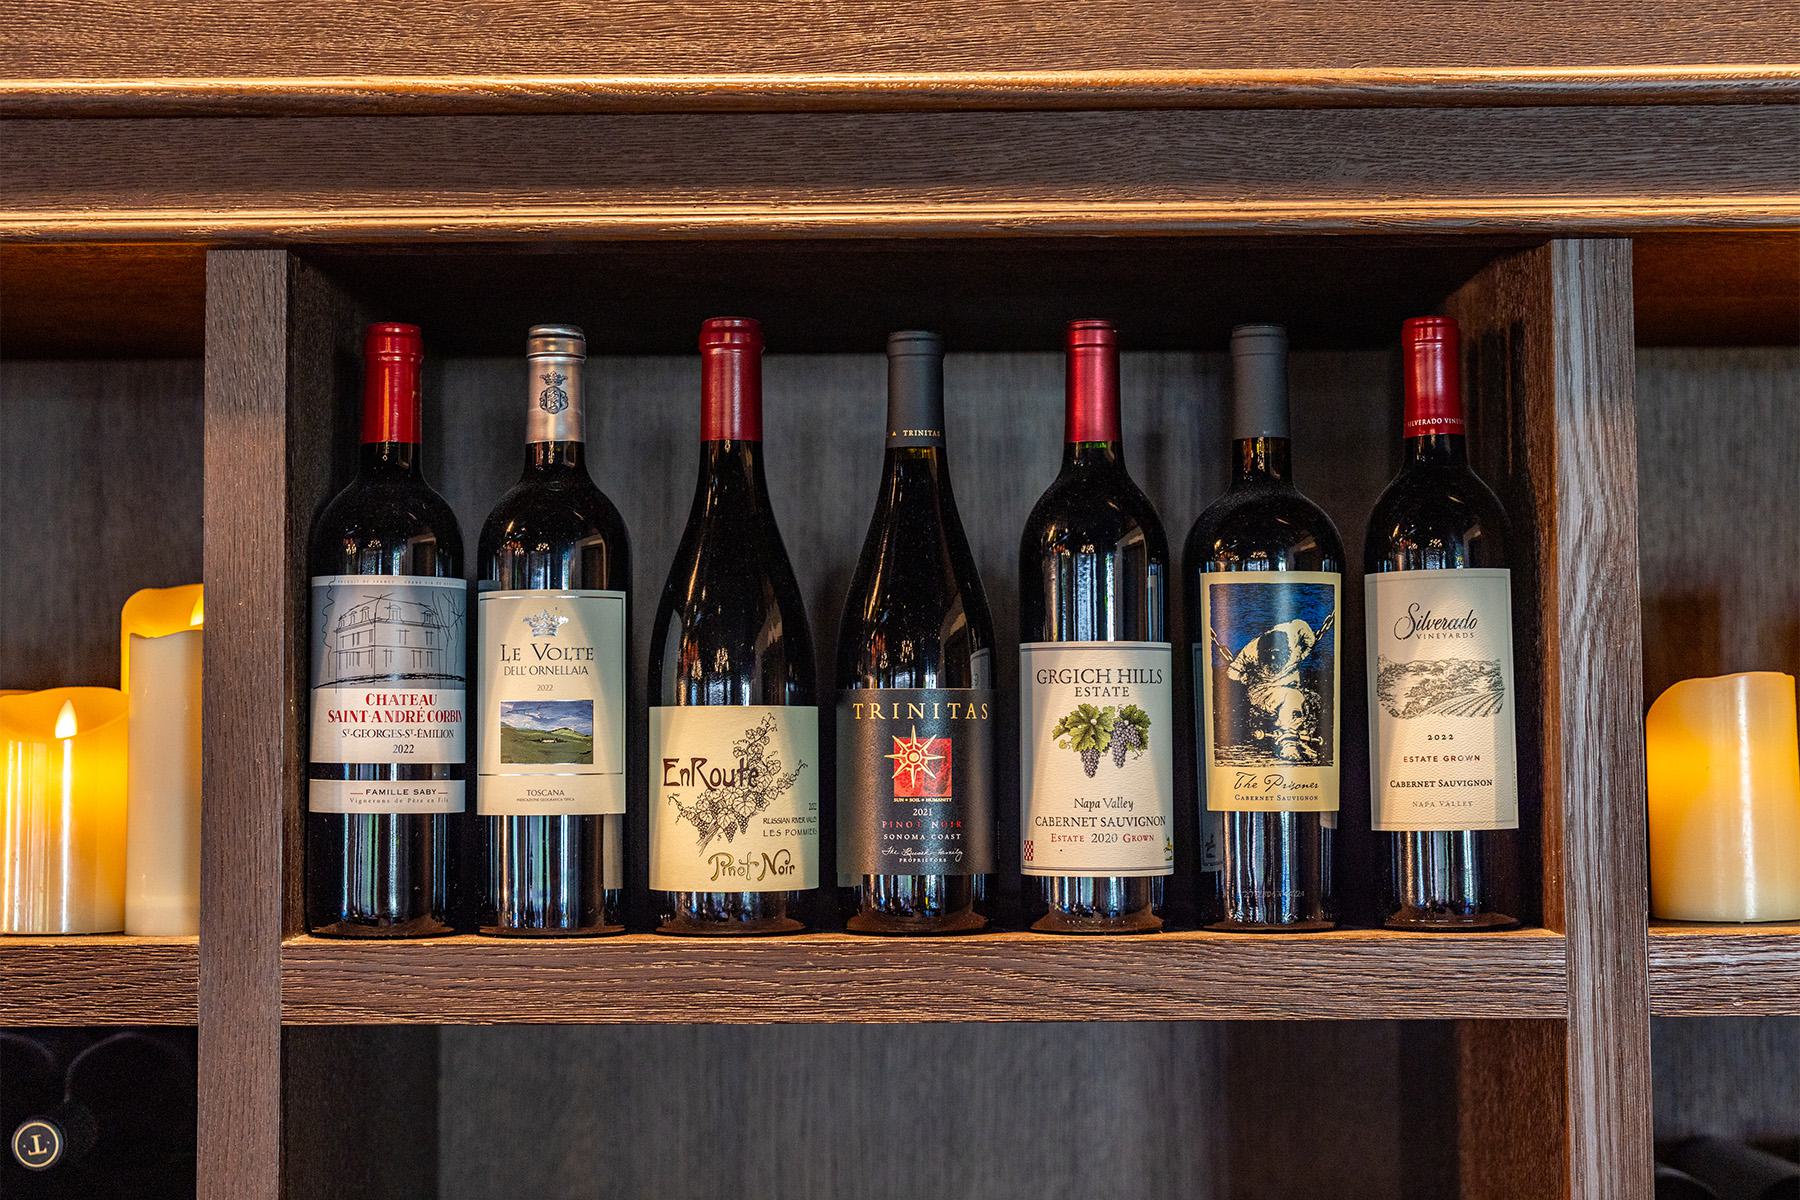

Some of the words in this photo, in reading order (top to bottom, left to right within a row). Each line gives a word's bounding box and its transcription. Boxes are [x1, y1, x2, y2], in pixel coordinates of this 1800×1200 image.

[1393, 602, 1478, 640] Silverado
[1416, 632, 1475, 640] VINEYARDS
[500, 643, 521, 662] LE
[530, 642, 594, 662] VOLTE
[503, 665, 527, 676] DELL'
[528, 665, 589, 676] ORNELLAIA
[1036, 668, 1111, 684] GRGICH
[1117, 668, 1163, 684] HILLS
[536, 684, 554, 692] 2022
[1074, 686, 1130, 697] ESTATE
[365, 693, 438, 706] CHATEAU
[852, 702, 989, 720] TRINITAS
[393, 743, 415, 754] 2022
[1403, 755, 1439, 763] ESTATE
[1443, 754, 1481, 762] GROWN
[662, 757, 759, 791] EnRoute
[1234, 771, 1258, 790] The
[1264, 774, 1320, 793] Prisoner
[1389, 779, 1437, 788] CABERNET
[1438, 779, 1493, 788] SAUVIGNON
[365, 788, 409, 796] FAMILLE
[413, 788, 437, 796] SABY
[526, 789, 565, 797] TOSCANA
[1073, 798, 1100, 812] Napa
[1102, 797, 1135, 812] Valley
[1439, 800, 1473, 808] VALLEY
[912, 808, 933, 816] 2021
[882, 820, 922, 829] PINOT
[931, 820, 962, 829] NOIR
[1034, 816, 1098, 828] CABERNET
[1100, 815, 1167, 828] SAUVIGNON
[762, 829, 782, 837] LES
[1050, 832, 1085, 843] ESTATE
[1091, 833, 1118, 843] 2020
[1122, 833, 1155, 843] GROWN
[707, 850, 760, 882] Pinot
[757, 848, 796, 882] Noir
